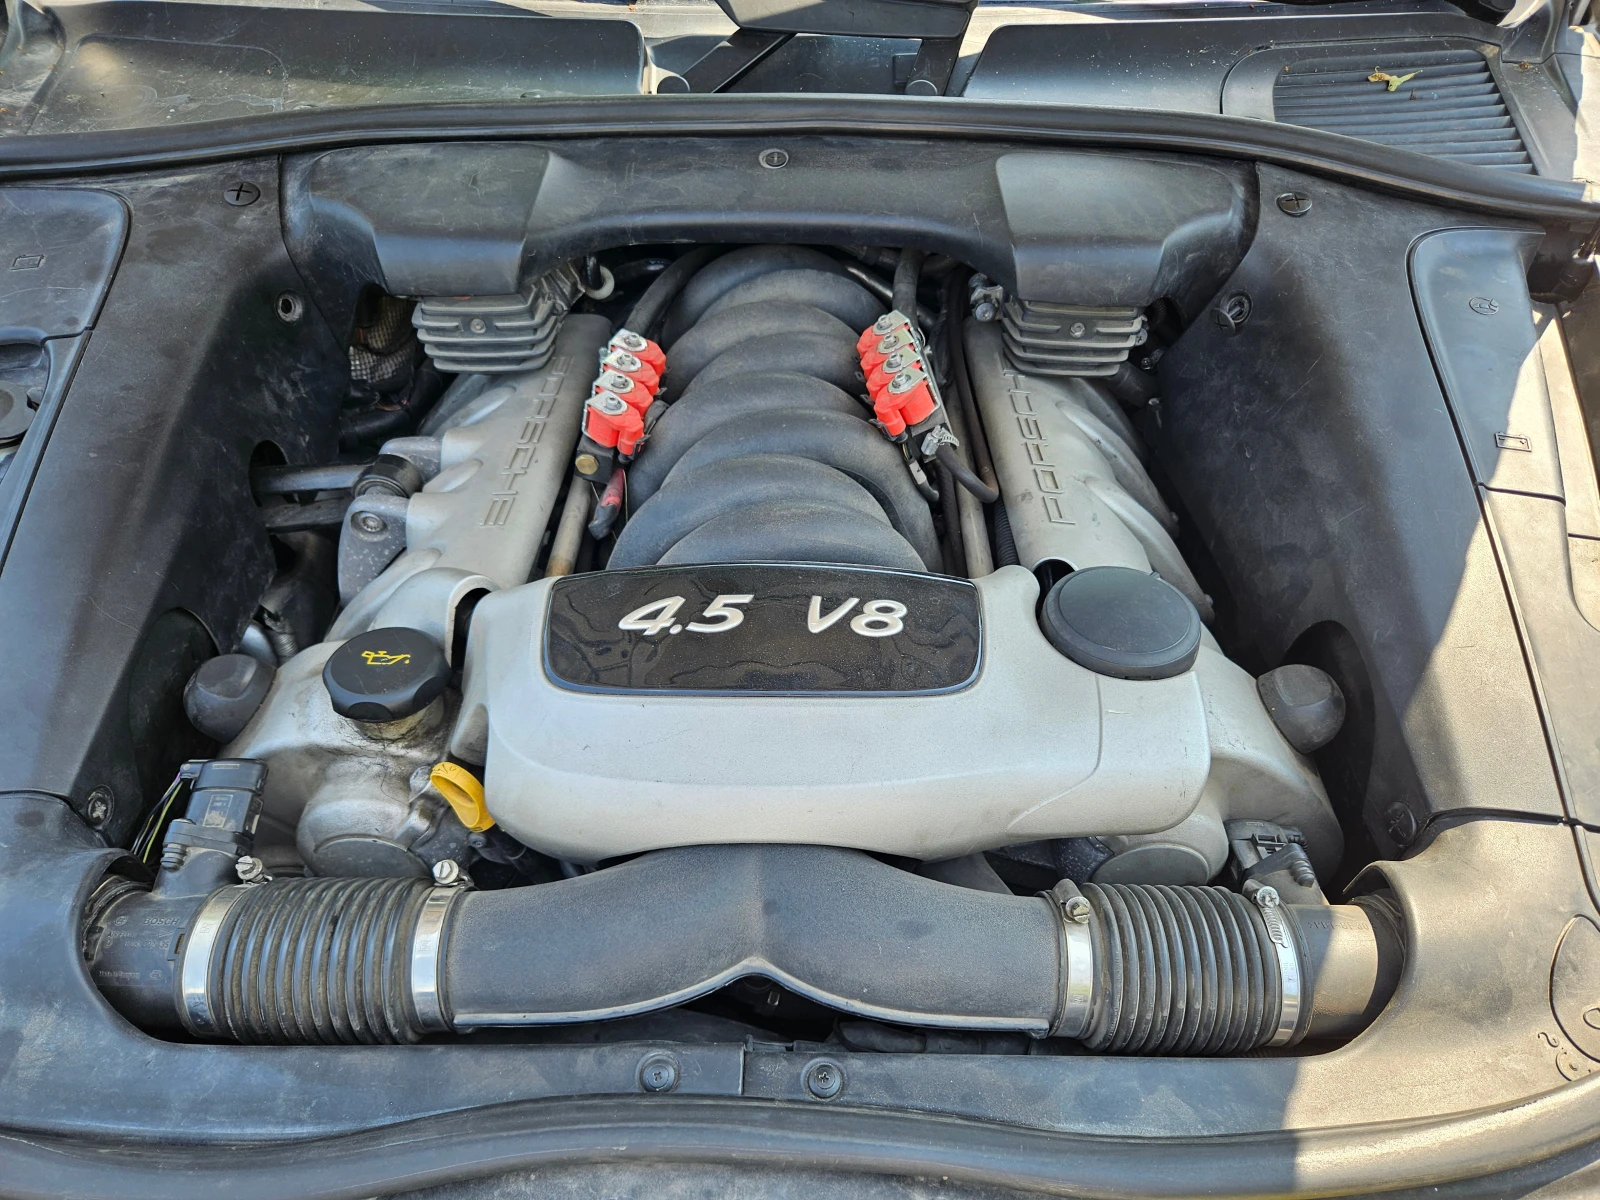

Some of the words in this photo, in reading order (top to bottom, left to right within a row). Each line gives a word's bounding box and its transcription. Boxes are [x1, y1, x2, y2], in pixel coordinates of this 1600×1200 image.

[478, 355, 573, 526] PORSCHE
[618, 595, 755, 636] 4.5
[807, 596, 908, 637] V8
[143, 918, 179, 926] BOSCH
